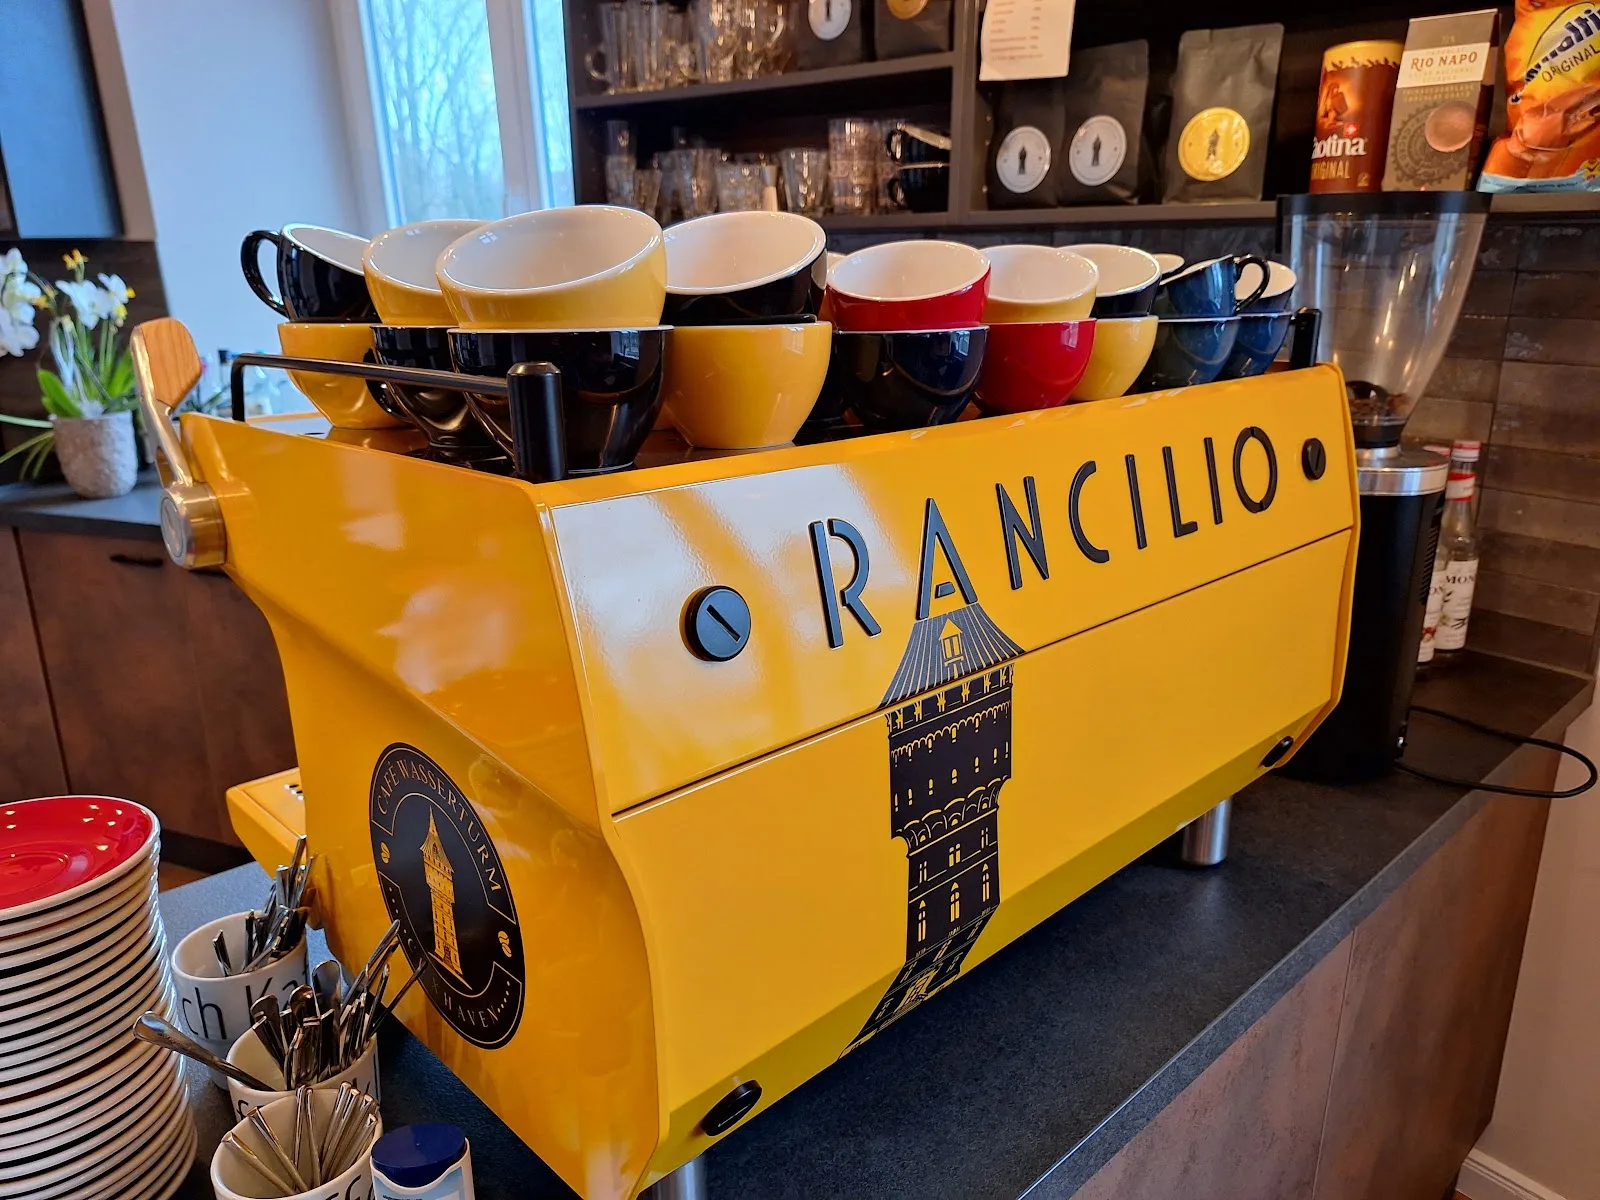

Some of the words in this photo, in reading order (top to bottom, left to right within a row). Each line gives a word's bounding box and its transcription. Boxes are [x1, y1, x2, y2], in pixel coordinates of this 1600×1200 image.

[1411, 56, 1434, 72] RIO
[1438, 51, 1478, 67] NAPO
[807, 426, 1278, 649] RANCILIO
[377, 760, 400, 815] CAFÉ
[396, 759, 502, 892] WASSERTURM
